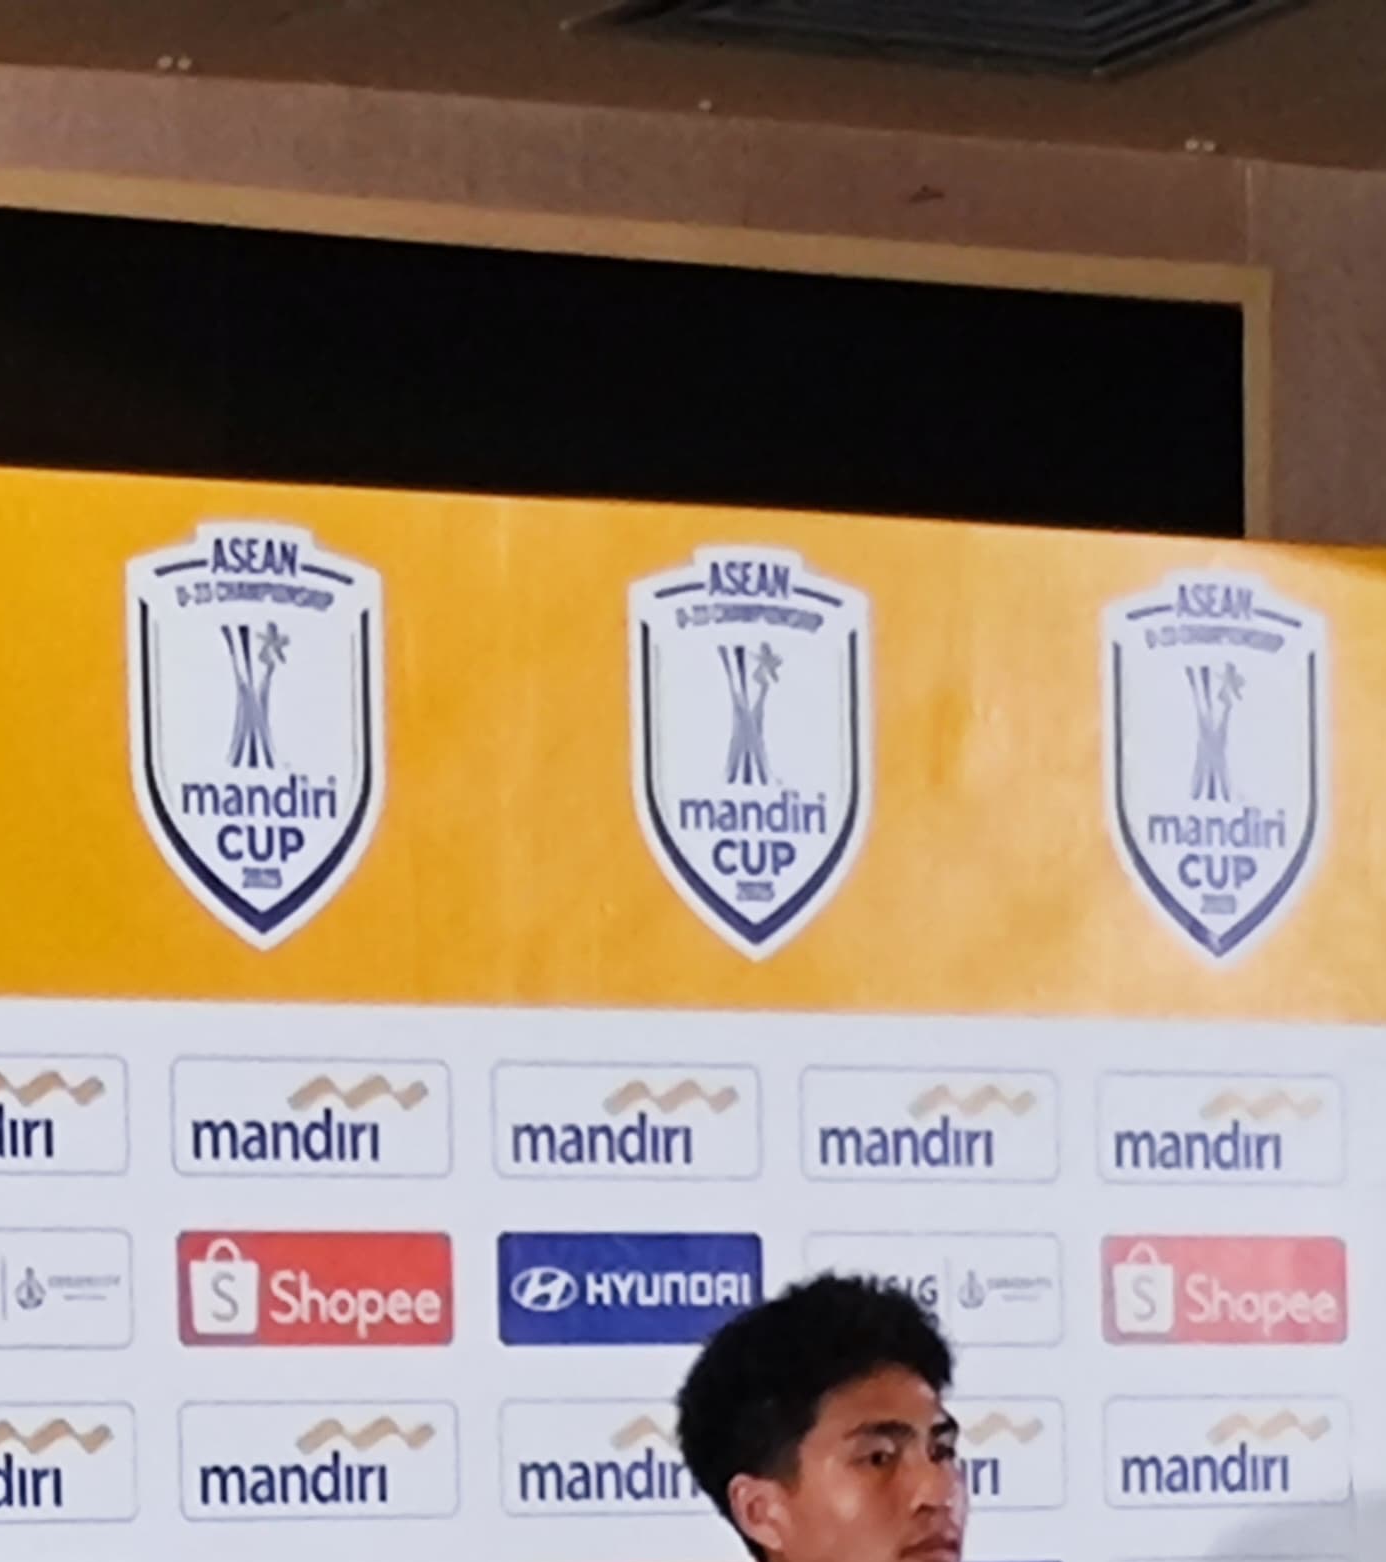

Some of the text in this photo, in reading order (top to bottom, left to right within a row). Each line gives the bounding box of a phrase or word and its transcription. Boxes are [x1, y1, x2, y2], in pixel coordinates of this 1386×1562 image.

[211, 537, 298, 577] ASEAN
[710, 561, 790, 598] ASEAN
[1176, 584, 1253, 620] ASEAN
[181, 773, 337, 820] mandiri
[679, 789, 827, 835] mandiri
[216, 823, 305, 863] CUP
[1147, 806, 1286, 849] mandiri
[711, 838, 797, 877] CUP
[1177, 852, 1258, 891] CUP
[191, 1107, 380, 1162] mandiri
[512, 1110, 693, 1165] mandiri
[819, 1114, 994, 1168] mandiri
[1114, 1119, 1282, 1171] mandiri
[269, 1269, 442, 1339] Shopee
[586, 1271, 752, 1306] HYUNDAI
[1185, 1271, 1339, 1337] Shopee
[199, 1449, 388, 1506] mandiri
[1121, 1441, 1289, 1494] mandiri
